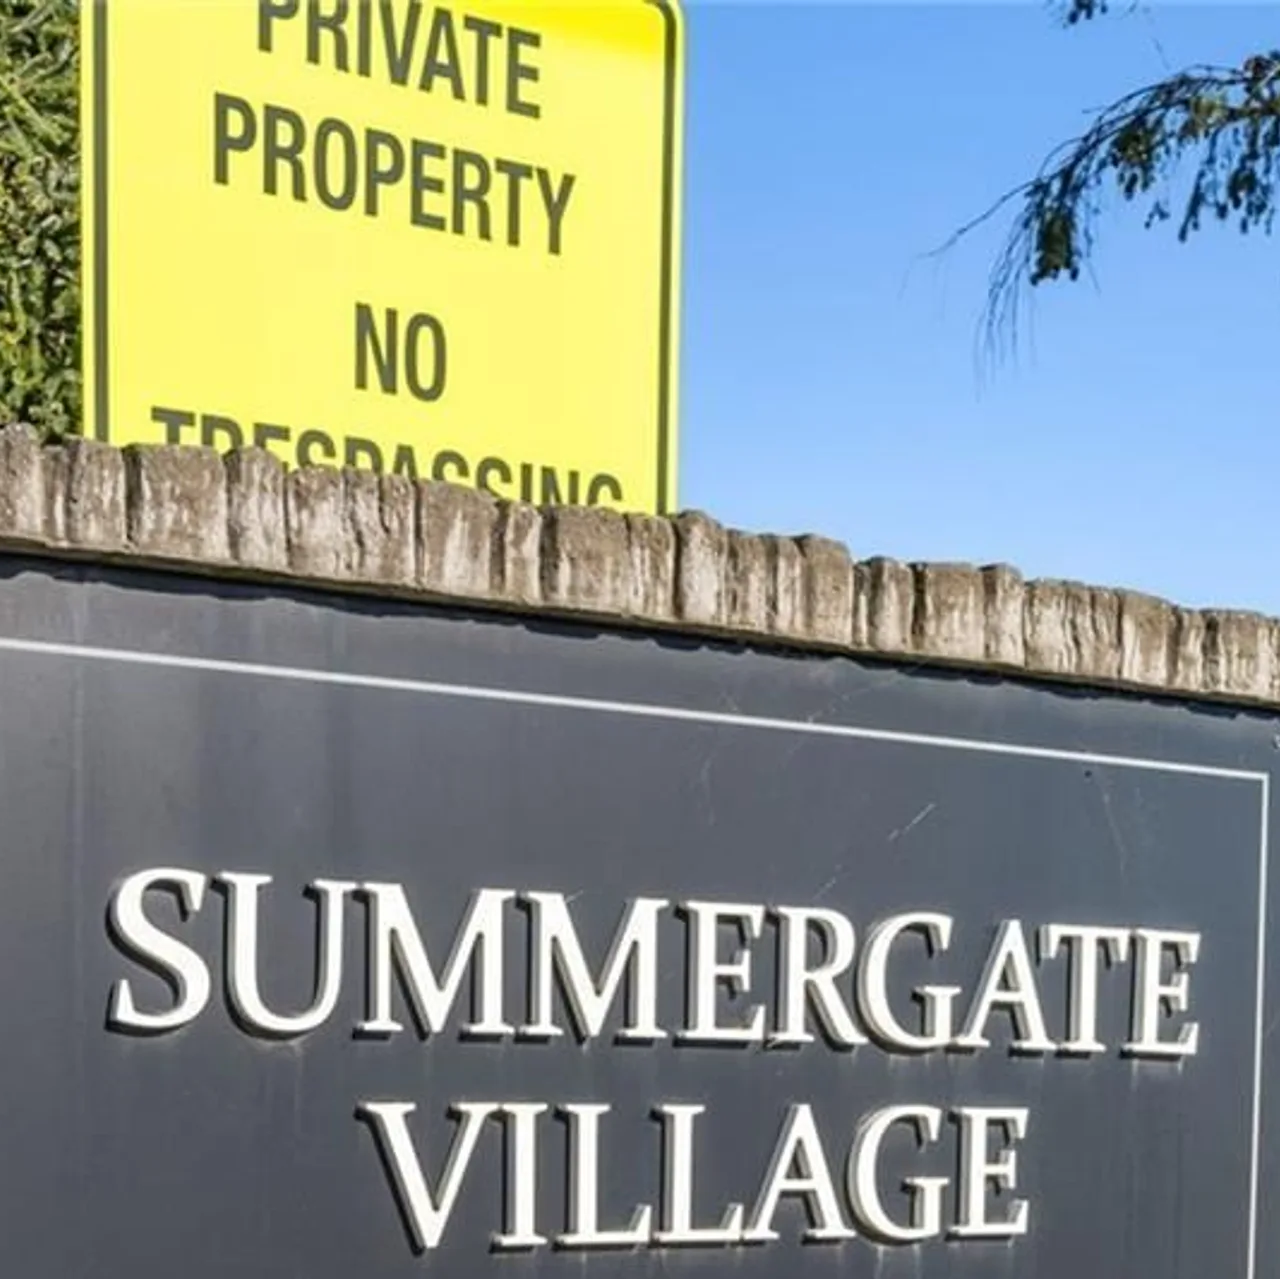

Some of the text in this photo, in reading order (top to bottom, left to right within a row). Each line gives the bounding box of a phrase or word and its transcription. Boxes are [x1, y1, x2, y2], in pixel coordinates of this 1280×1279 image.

[258, 0, 542, 119] PRIVATE
[213, 91, 577, 256] PROPERTY
[354, 301, 448, 402] NO
[106, 866, 1201, 1060] SUMMERGATE
[358, 1100, 1030, 1253] VILLAGE
